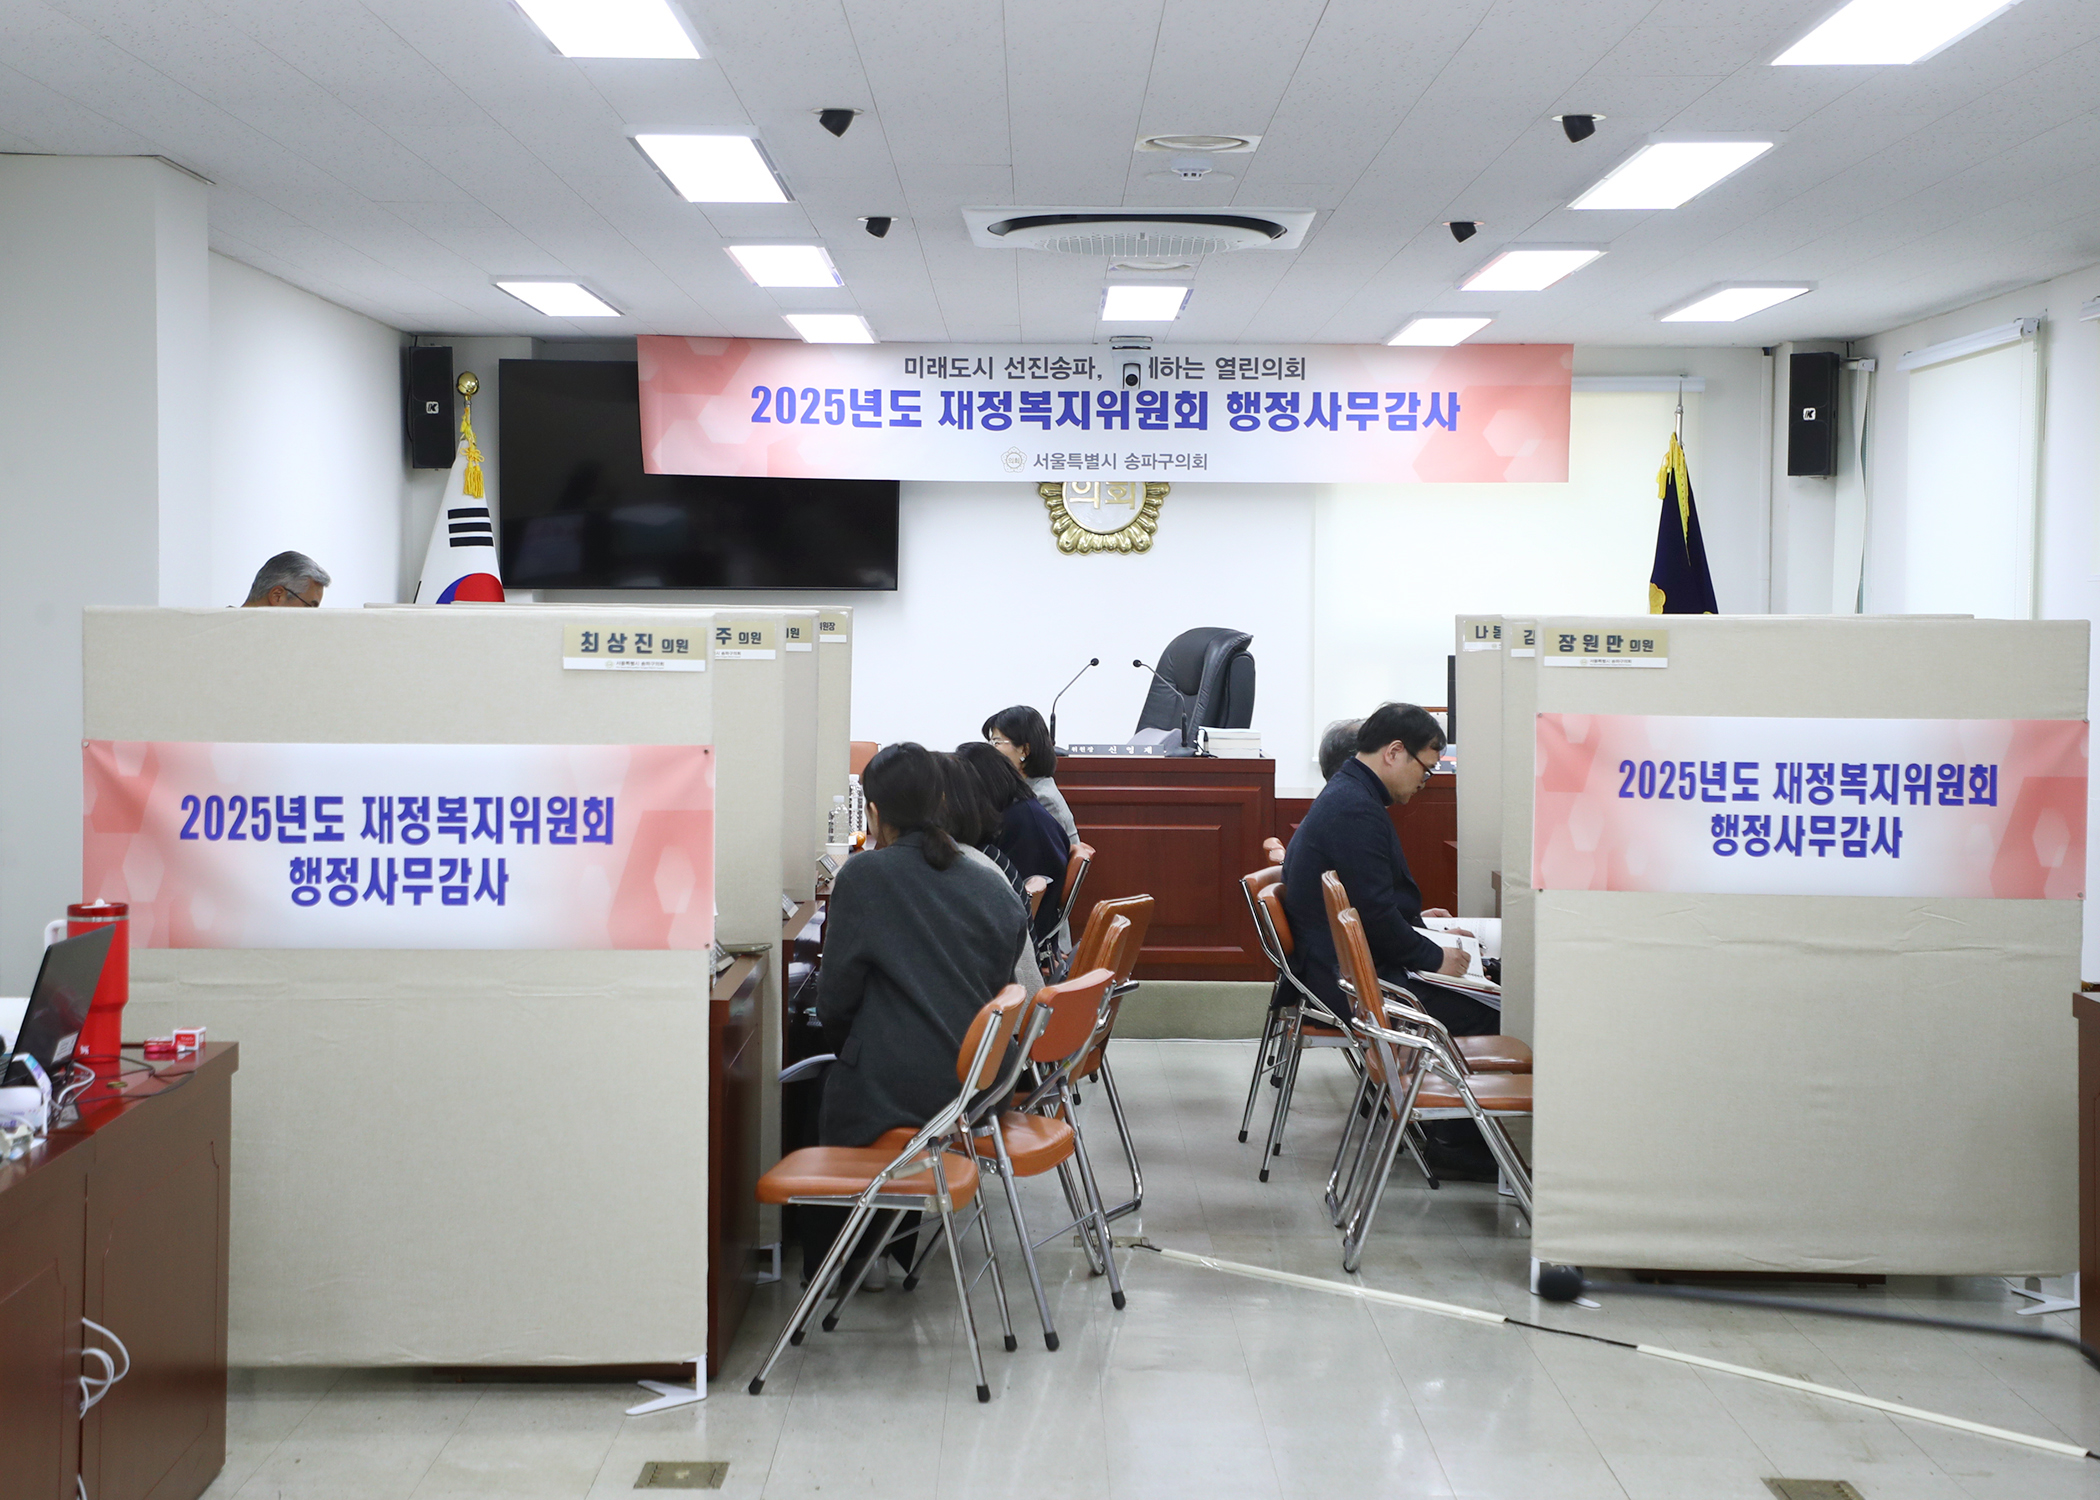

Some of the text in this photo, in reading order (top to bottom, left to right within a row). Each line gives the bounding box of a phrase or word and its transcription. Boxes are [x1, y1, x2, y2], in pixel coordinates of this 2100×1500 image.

[904, 356, 994, 380] 미래도시
[1003, 356, 1104, 382] 선진송파,
[1215, 356, 1306, 380] 열린의회
[751, 385, 1461, 432] 2025년도 재정복지위원회 행정사무감사
[1033, 452, 1208, 471] 서울특별시 송파구의회
[580, 631, 689, 654] 최상진 의원
[738, 631, 762, 645] 의원
[1558, 634, 1654, 653] 장원만 의원
[1618, 759, 1998, 807] 2025년도 재정복지위원회
[179, 794, 614, 846] 2025년도 재정복지위원회
[1711, 813, 1903, 859] 행정사무감사
[289, 856, 509, 907] 행정사무감사
